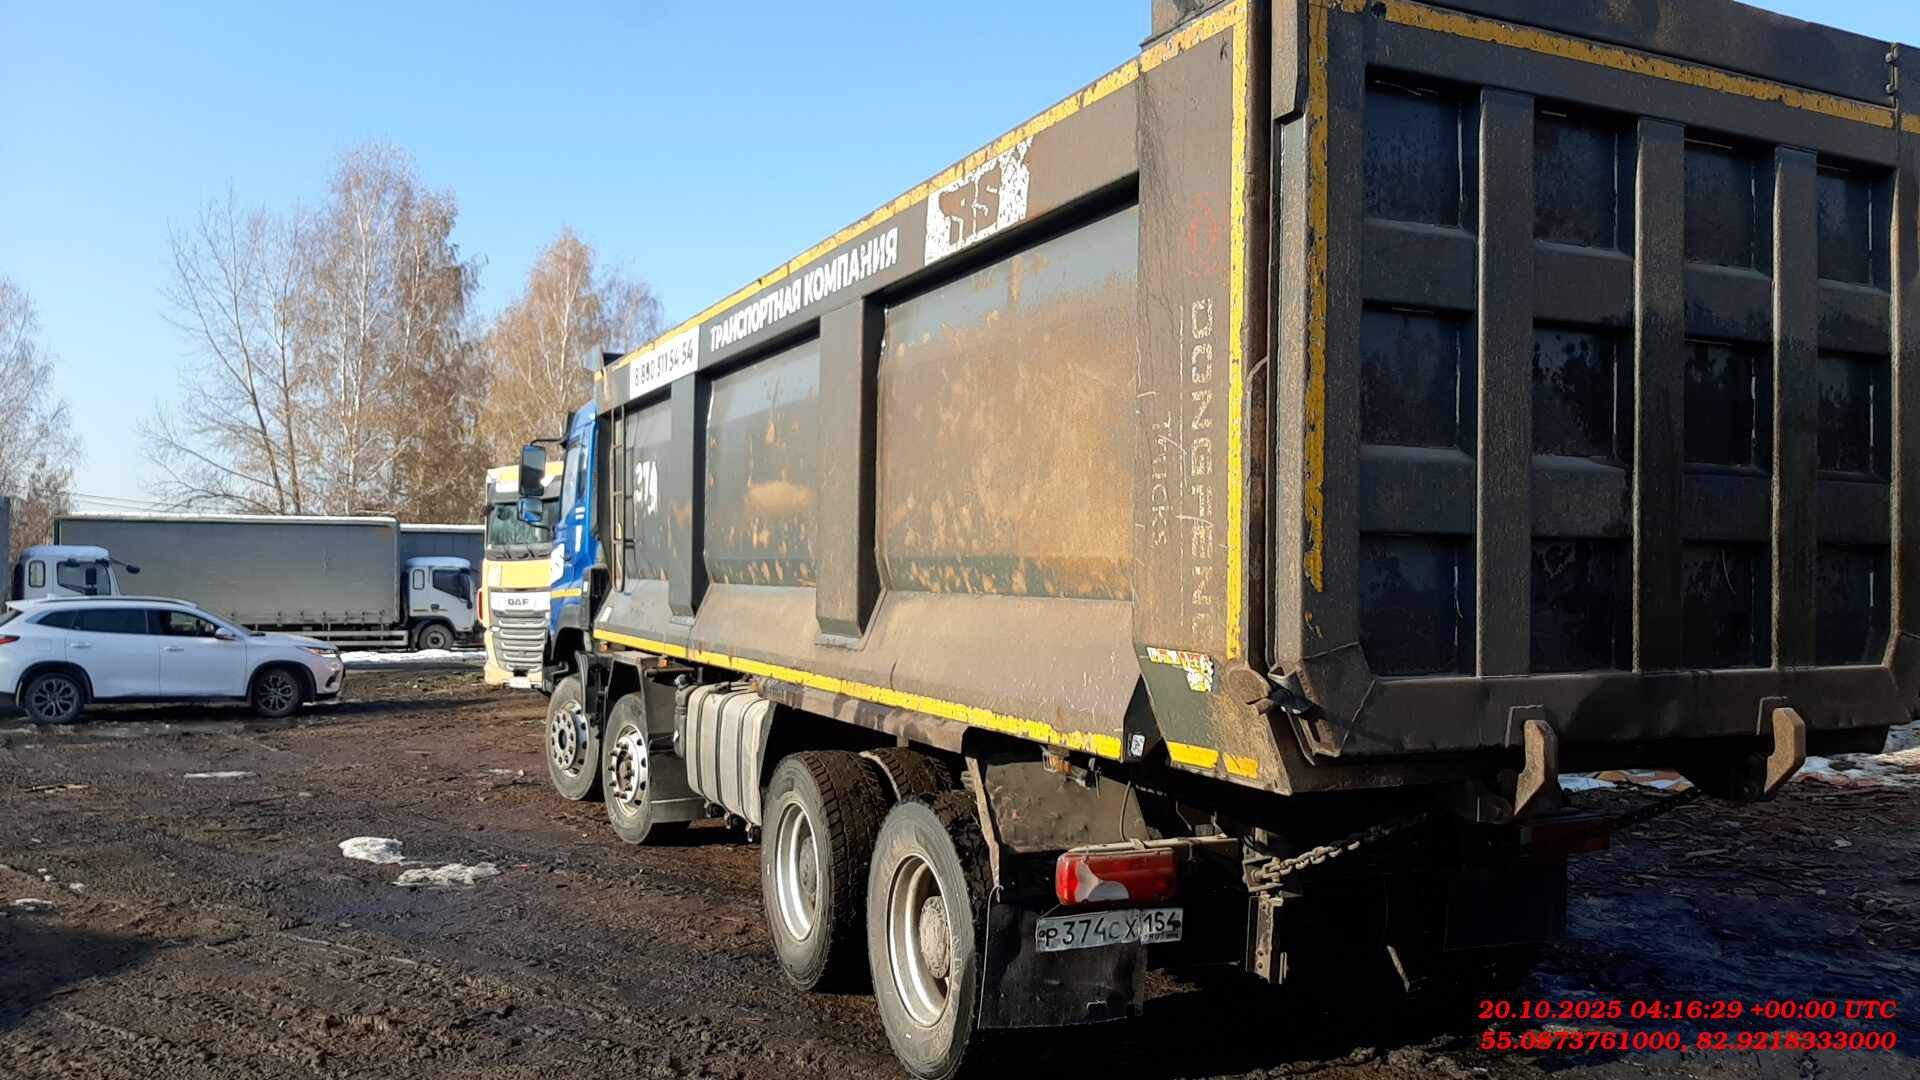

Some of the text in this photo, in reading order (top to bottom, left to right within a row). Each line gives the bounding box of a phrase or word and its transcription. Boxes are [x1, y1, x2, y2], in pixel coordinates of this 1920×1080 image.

[709, 227, 898, 353] ТРАНСПОРТНАЯ КОМПАНИЯ
[507, 598, 528, 606] DAF
